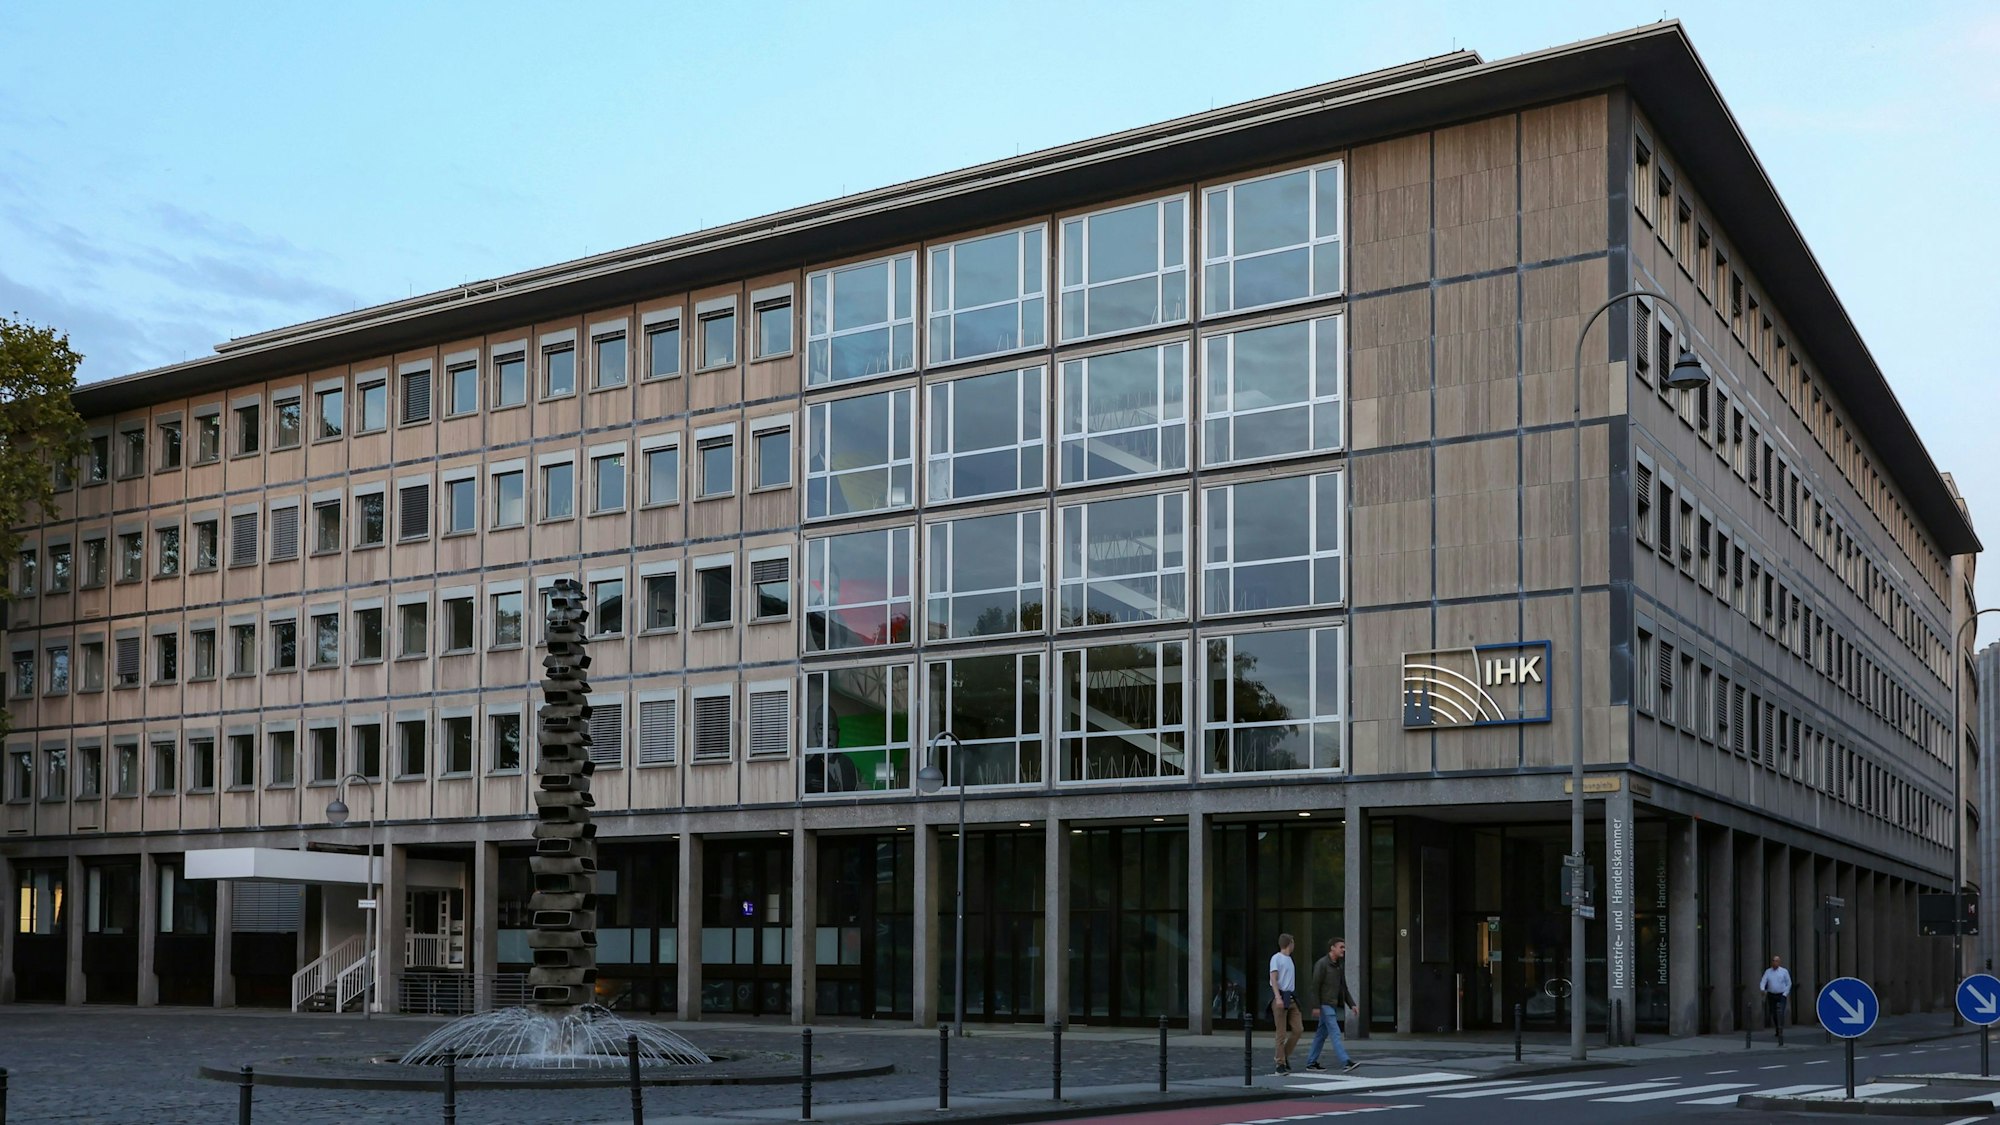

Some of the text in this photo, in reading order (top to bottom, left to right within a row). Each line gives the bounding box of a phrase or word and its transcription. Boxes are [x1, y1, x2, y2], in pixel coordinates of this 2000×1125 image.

[1485, 655, 1542, 686] IHK
[1611, 818, 1624, 989] Industrie- und Handelskammer
